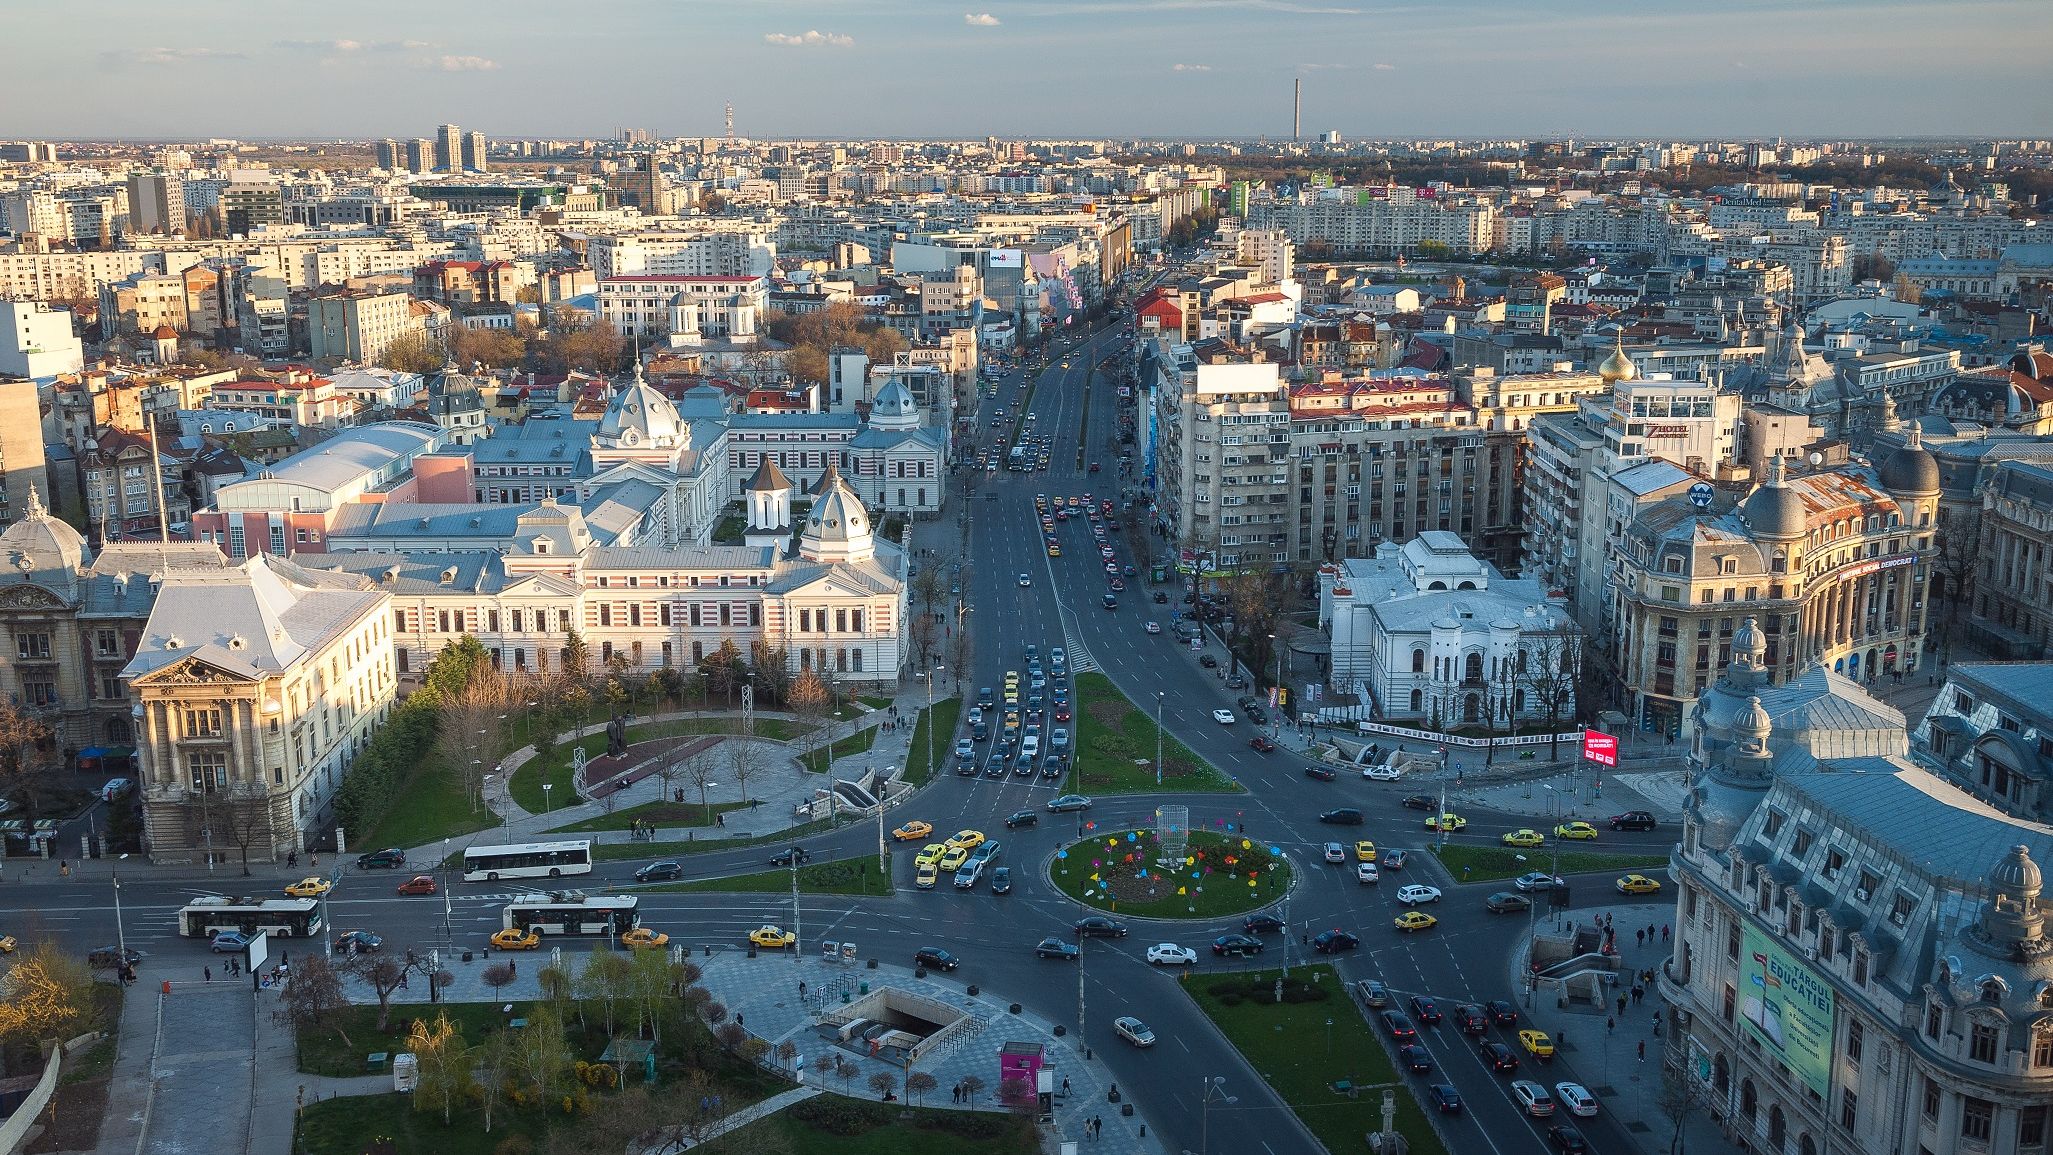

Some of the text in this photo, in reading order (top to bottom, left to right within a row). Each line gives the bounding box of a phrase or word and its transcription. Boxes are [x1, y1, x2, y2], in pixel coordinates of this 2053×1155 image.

[1721, 198, 1761, 206] DentalMed
[1659, 425, 1689, 433] HOTEL
[1881, 557, 1912, 568] DEMOCRAT
